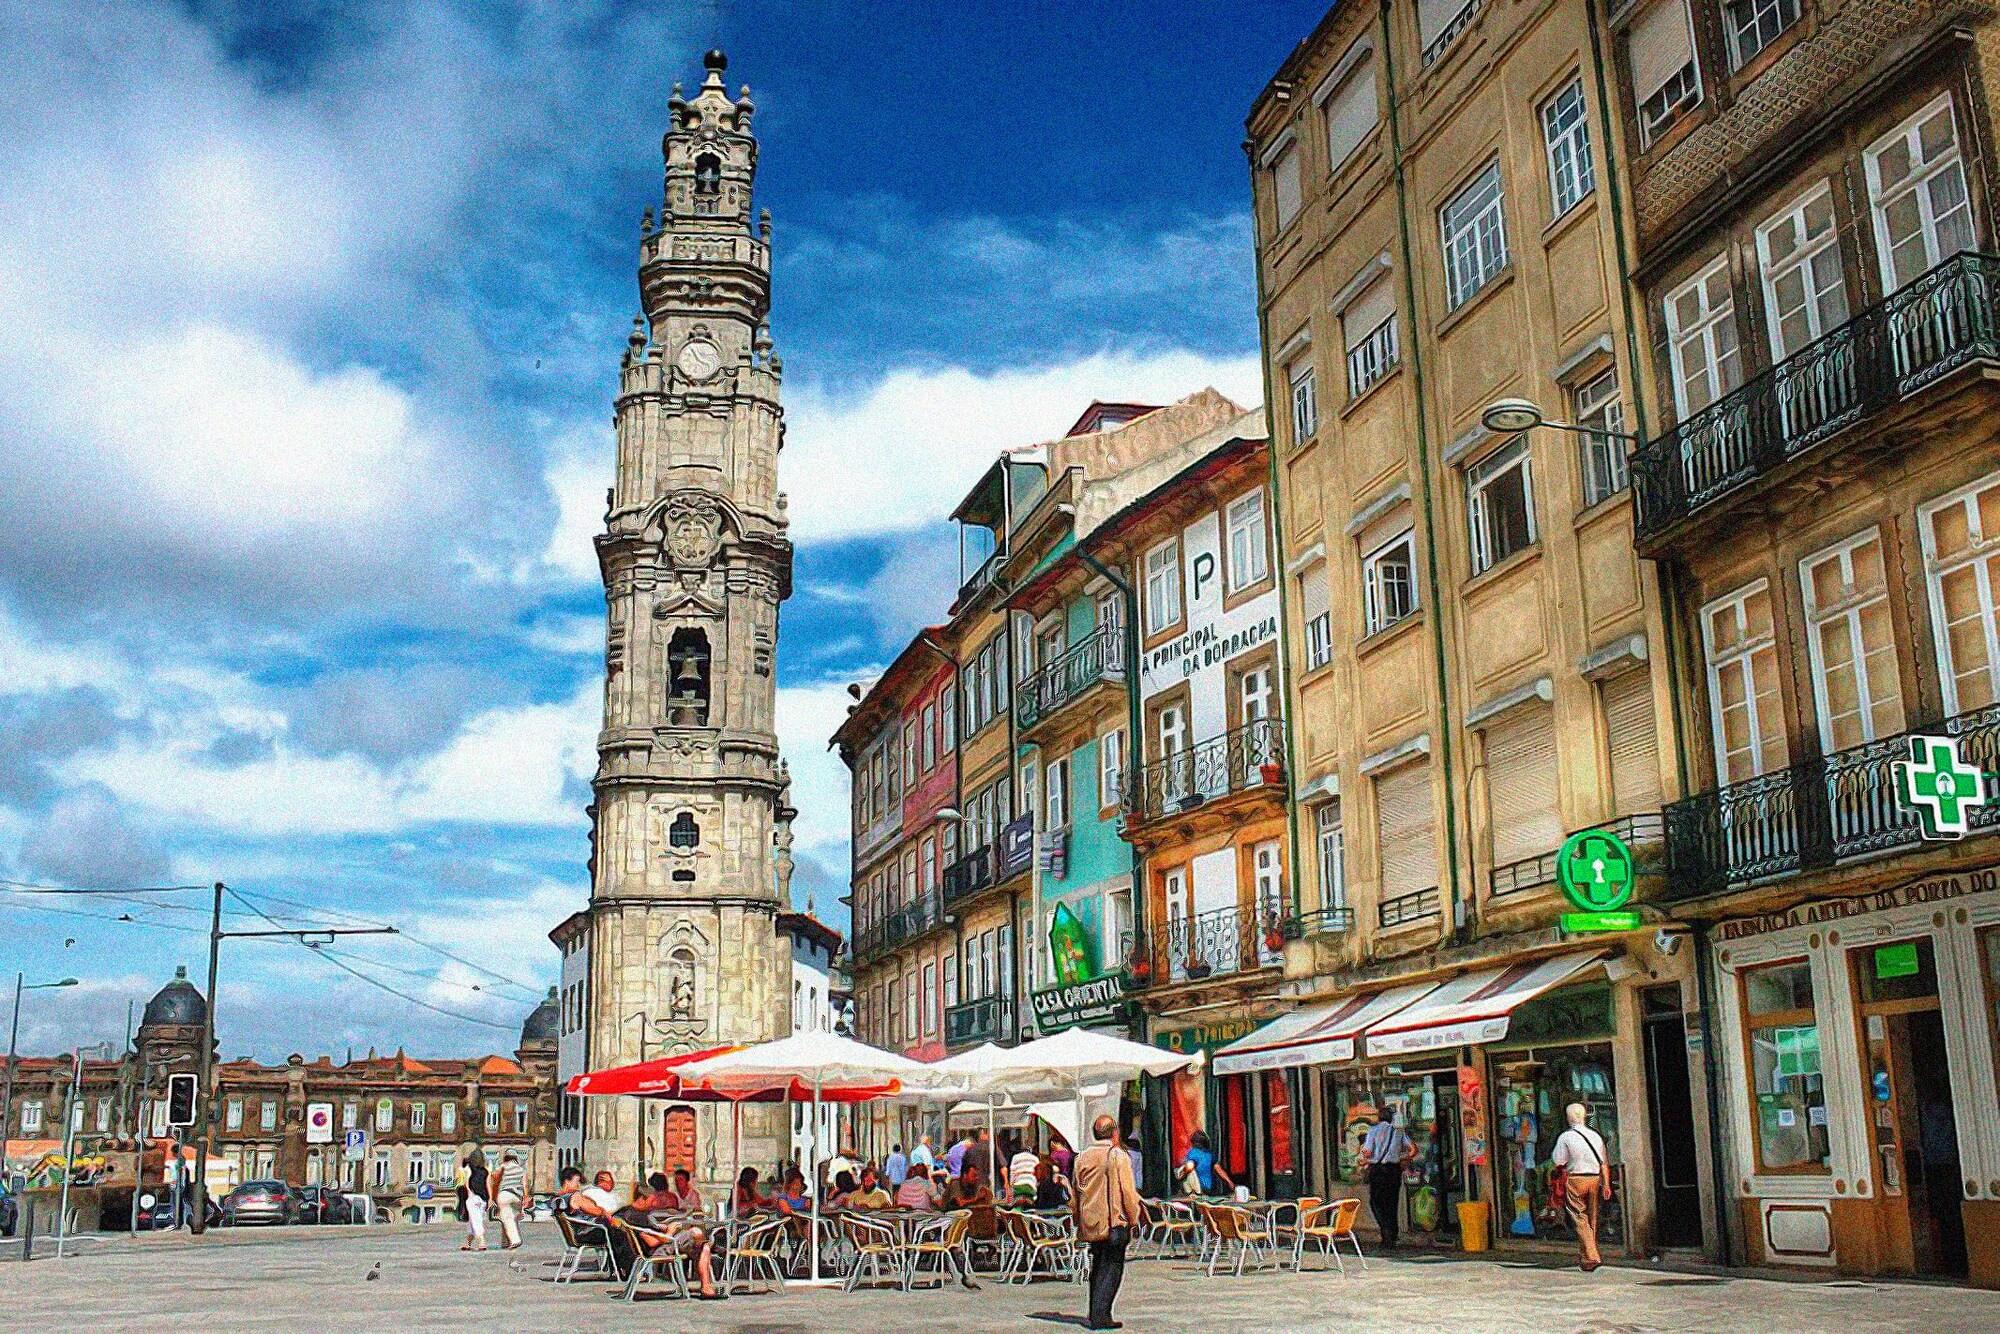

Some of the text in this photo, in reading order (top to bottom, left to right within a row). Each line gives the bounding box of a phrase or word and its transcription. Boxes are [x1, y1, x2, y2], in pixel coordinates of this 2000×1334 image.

[1194, 552, 1214, 600] P
[1142, 623, 1218, 674] A PRINCIPAL
[1183, 616, 1276, 677] DA BORRACHA
[1905, 879, 1962, 905] PORTA
[1970, 870, 1997, 892] DO
[1034, 976, 1122, 1014] CASA ORIENTAL
